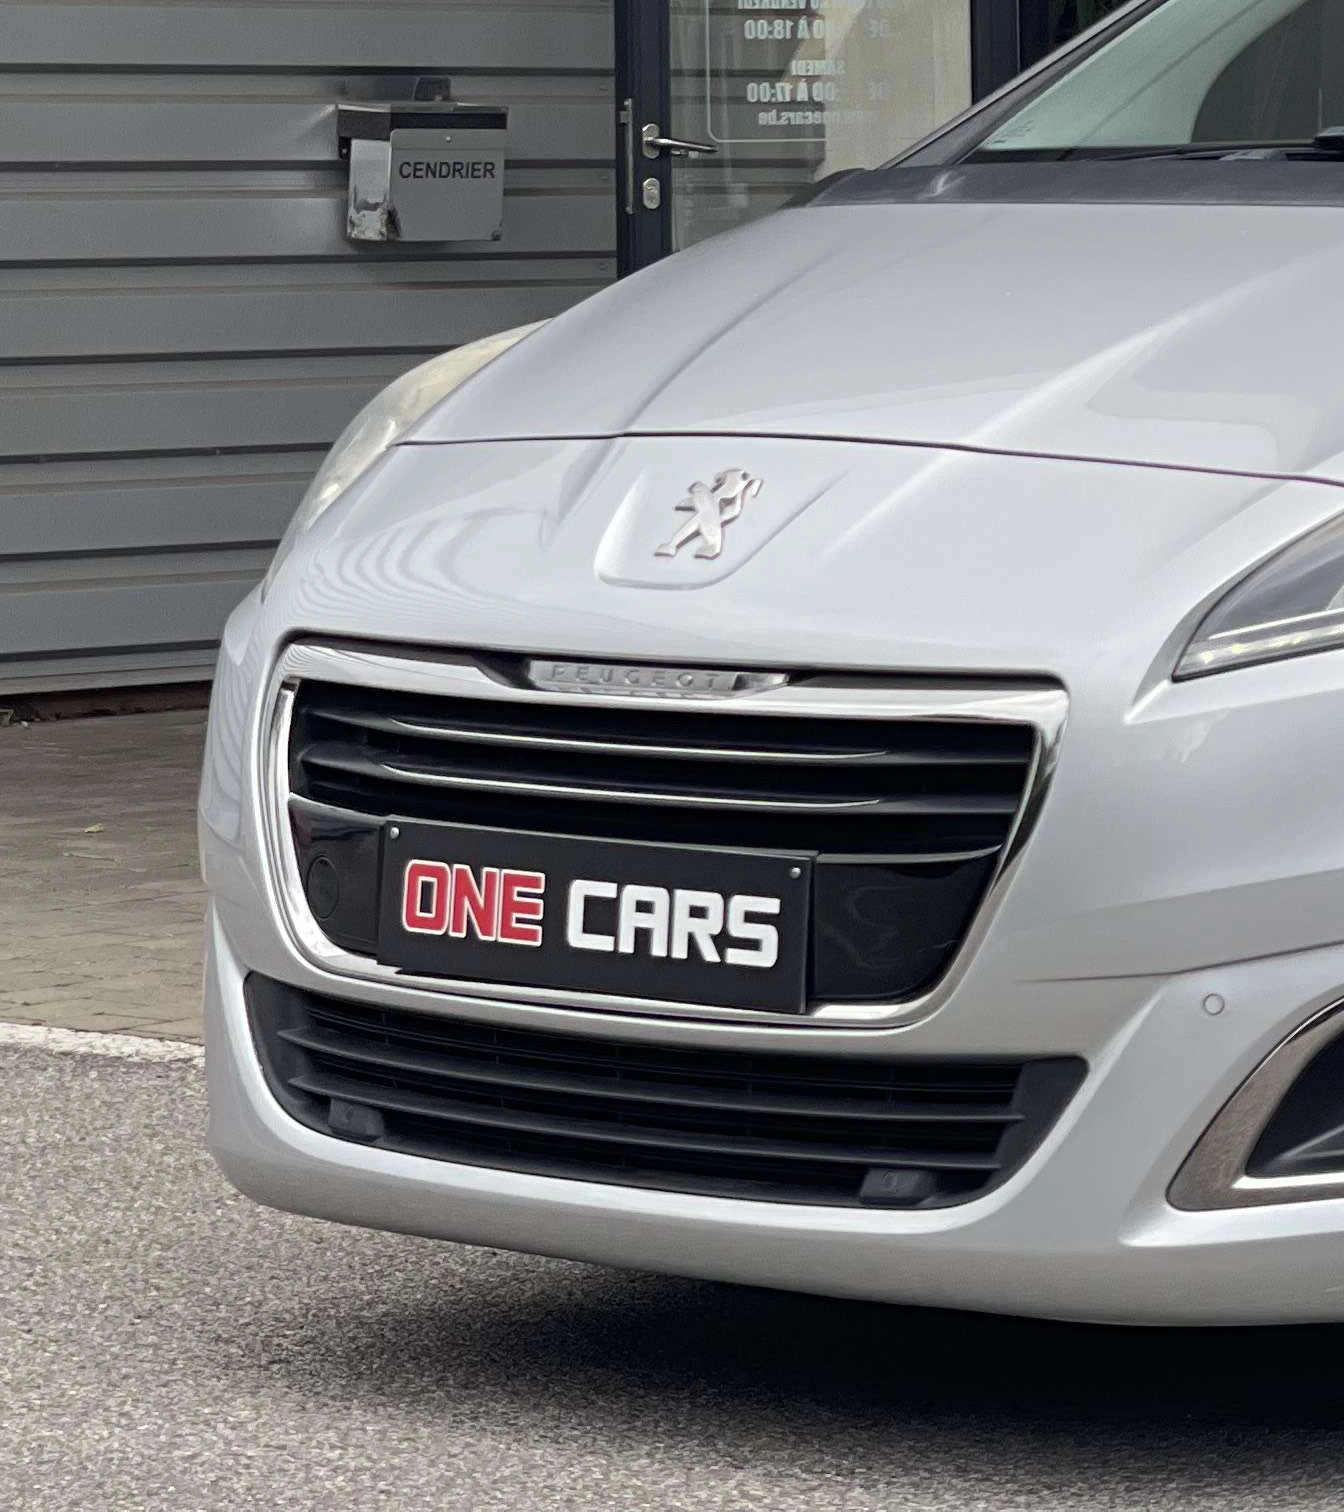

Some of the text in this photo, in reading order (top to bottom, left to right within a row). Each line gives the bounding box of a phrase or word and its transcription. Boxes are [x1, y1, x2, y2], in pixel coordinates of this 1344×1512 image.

[399, 161, 496, 180] CENDRIER
[551, 663, 720, 689] PEUGEOT
[402, 858, 782, 969] ONE CARS
